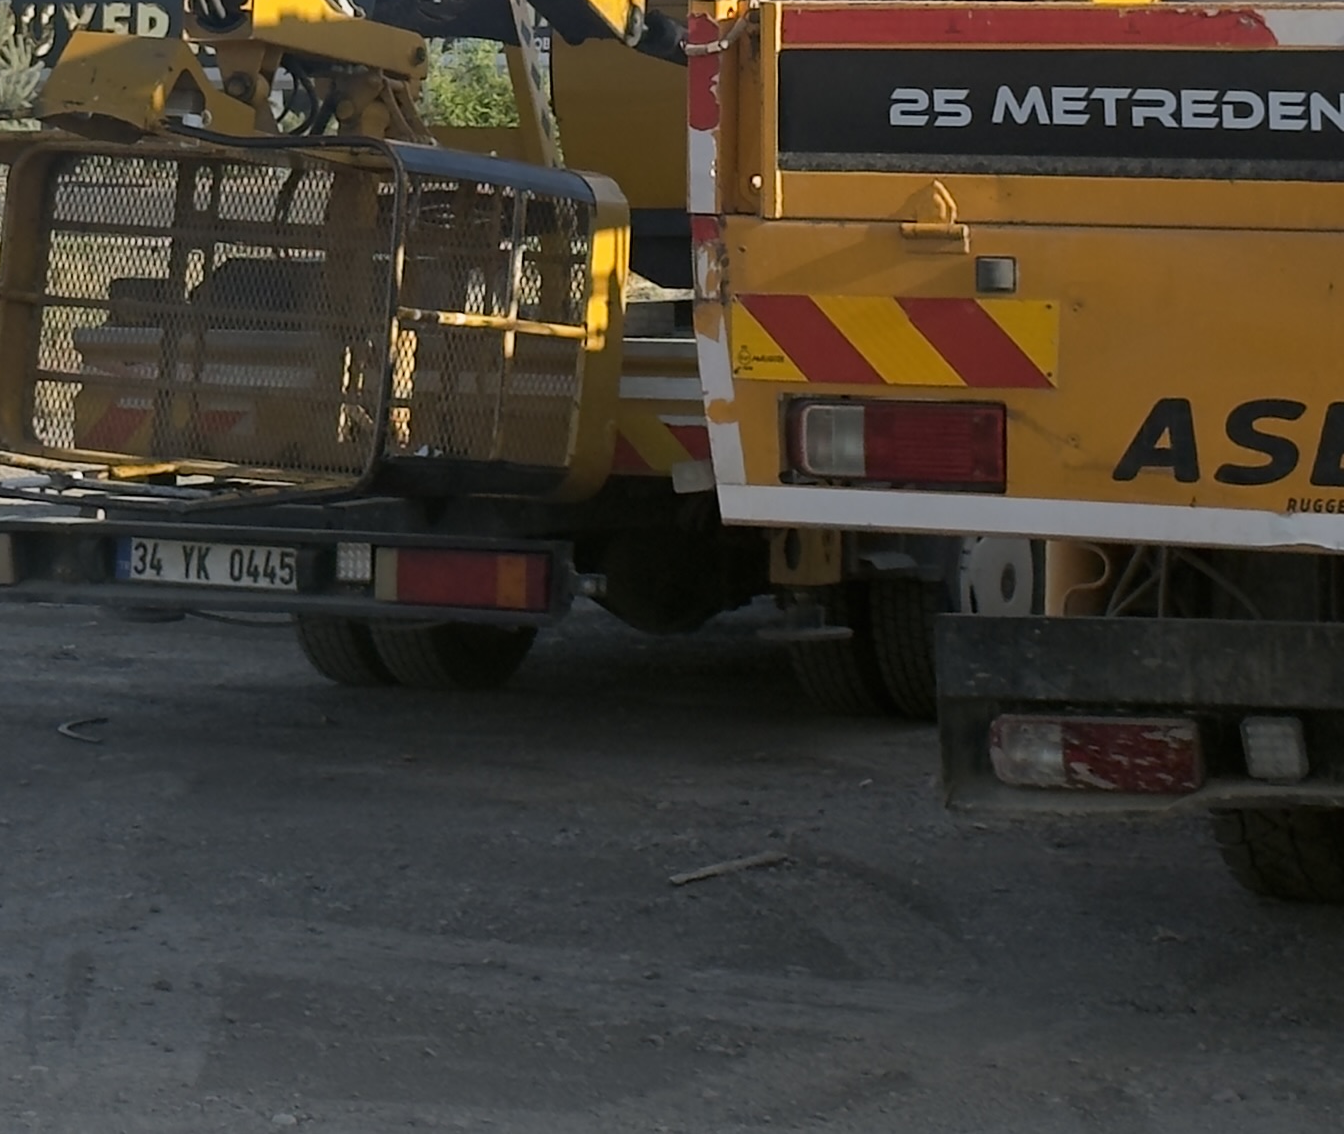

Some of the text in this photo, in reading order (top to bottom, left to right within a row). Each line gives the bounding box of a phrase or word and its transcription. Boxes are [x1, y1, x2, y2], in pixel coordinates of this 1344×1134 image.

[888, 87, 972, 128] 25
[133, 542, 295, 586] 34 YK 0445
